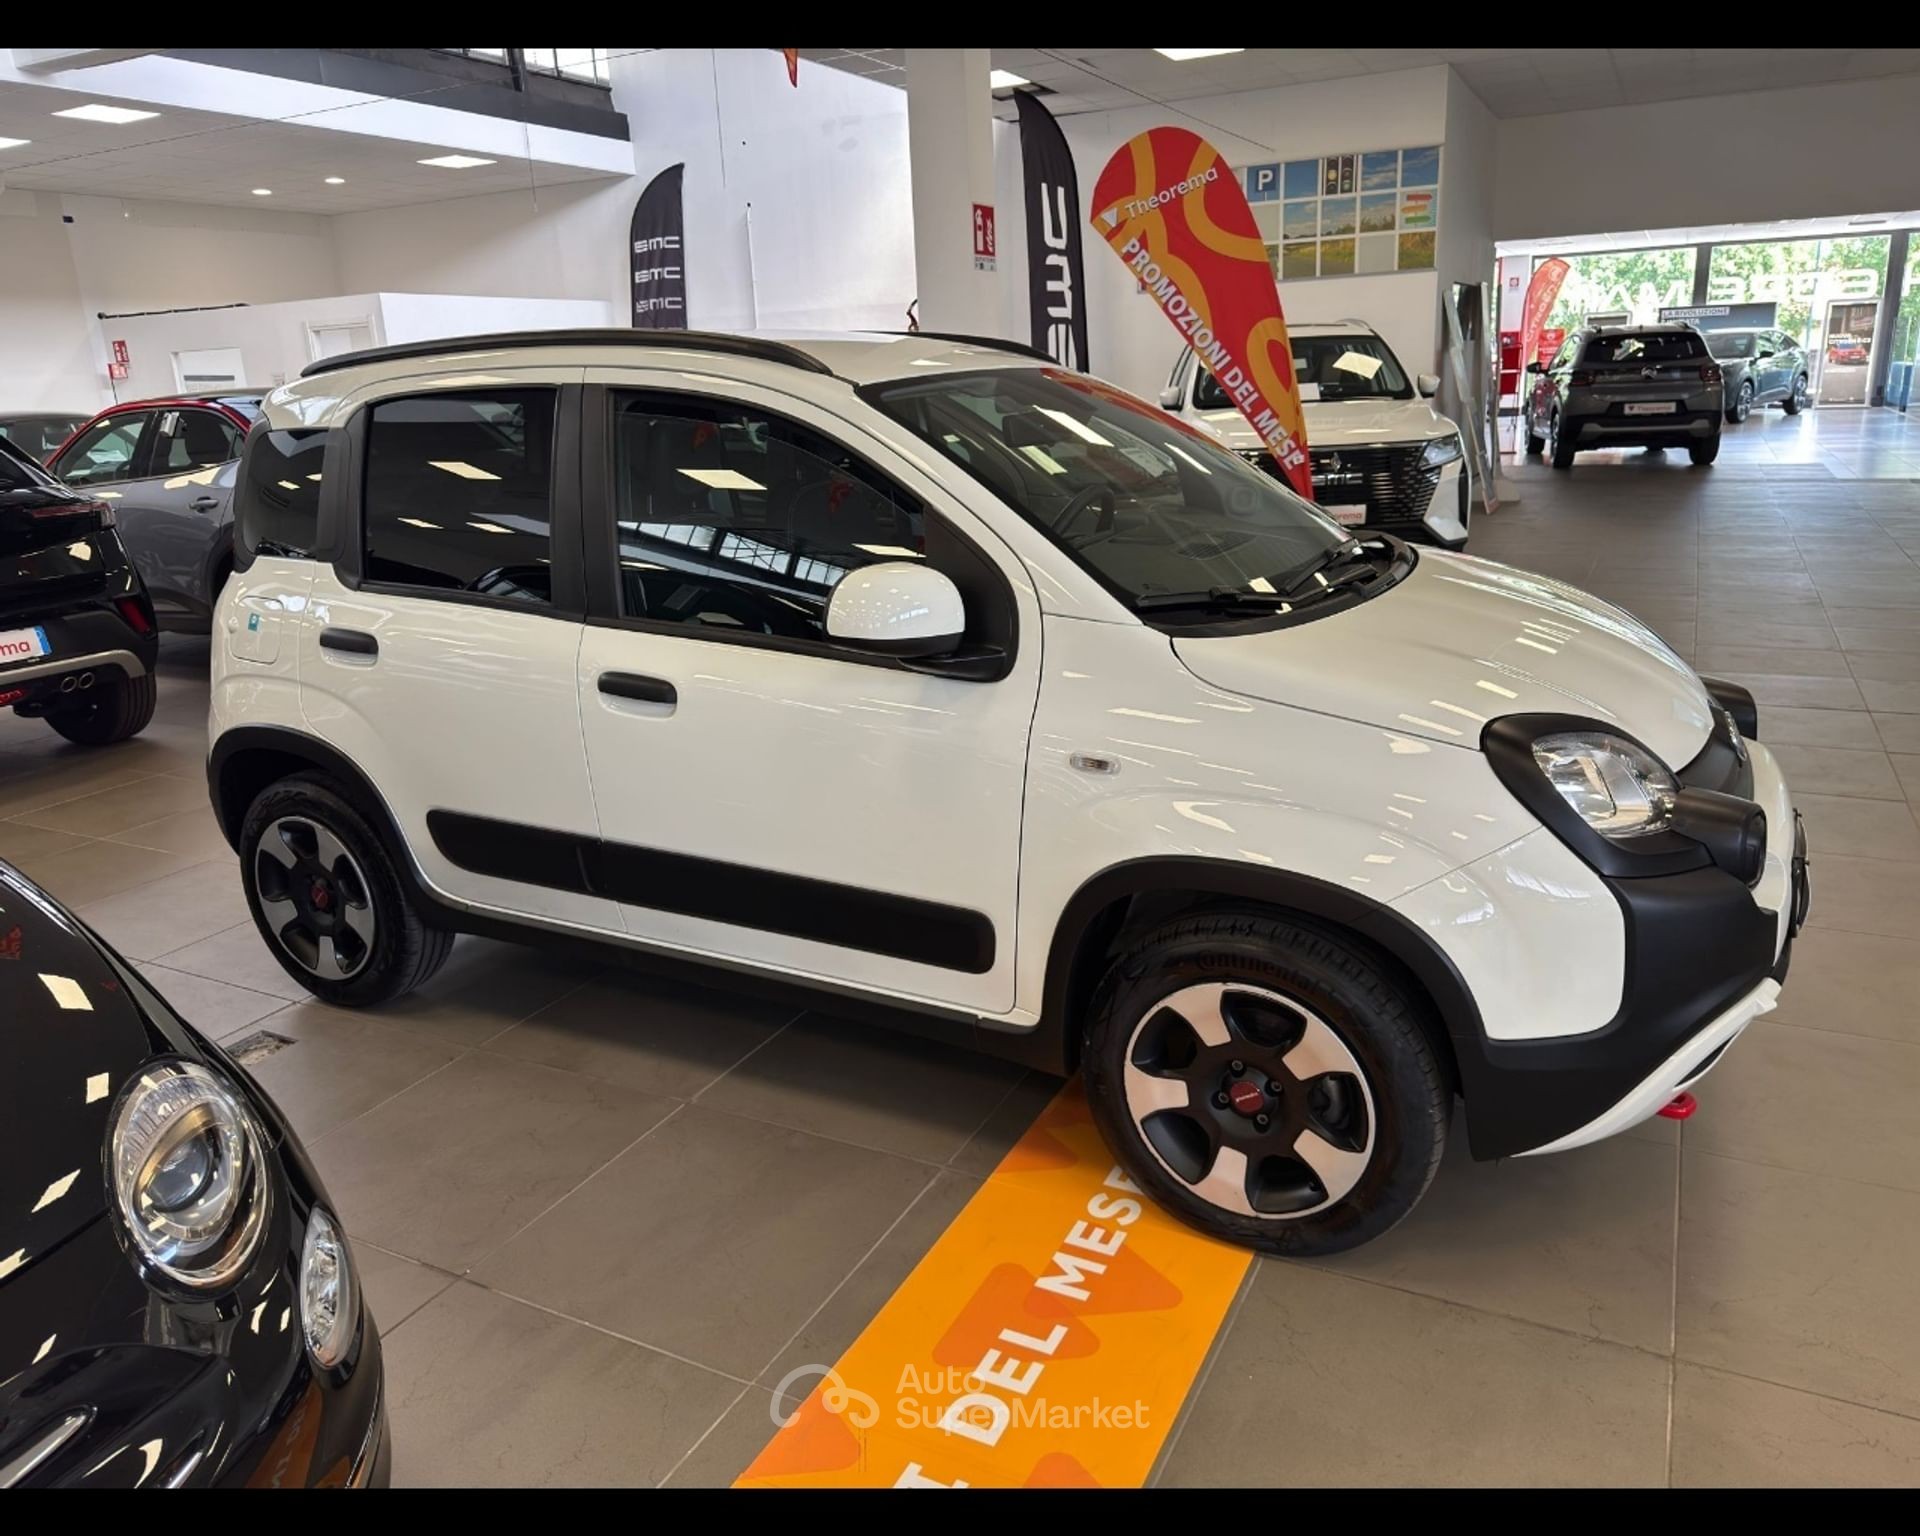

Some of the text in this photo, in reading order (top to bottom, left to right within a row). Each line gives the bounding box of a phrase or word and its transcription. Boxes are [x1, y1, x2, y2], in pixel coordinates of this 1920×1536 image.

[1125, 166, 1219, 218] Theorema
[1257, 169, 1273, 191] P
[1121, 238, 1305, 470] PROMOZIONI DEL MESE
[936, 1324, 1069, 1447] DEL
